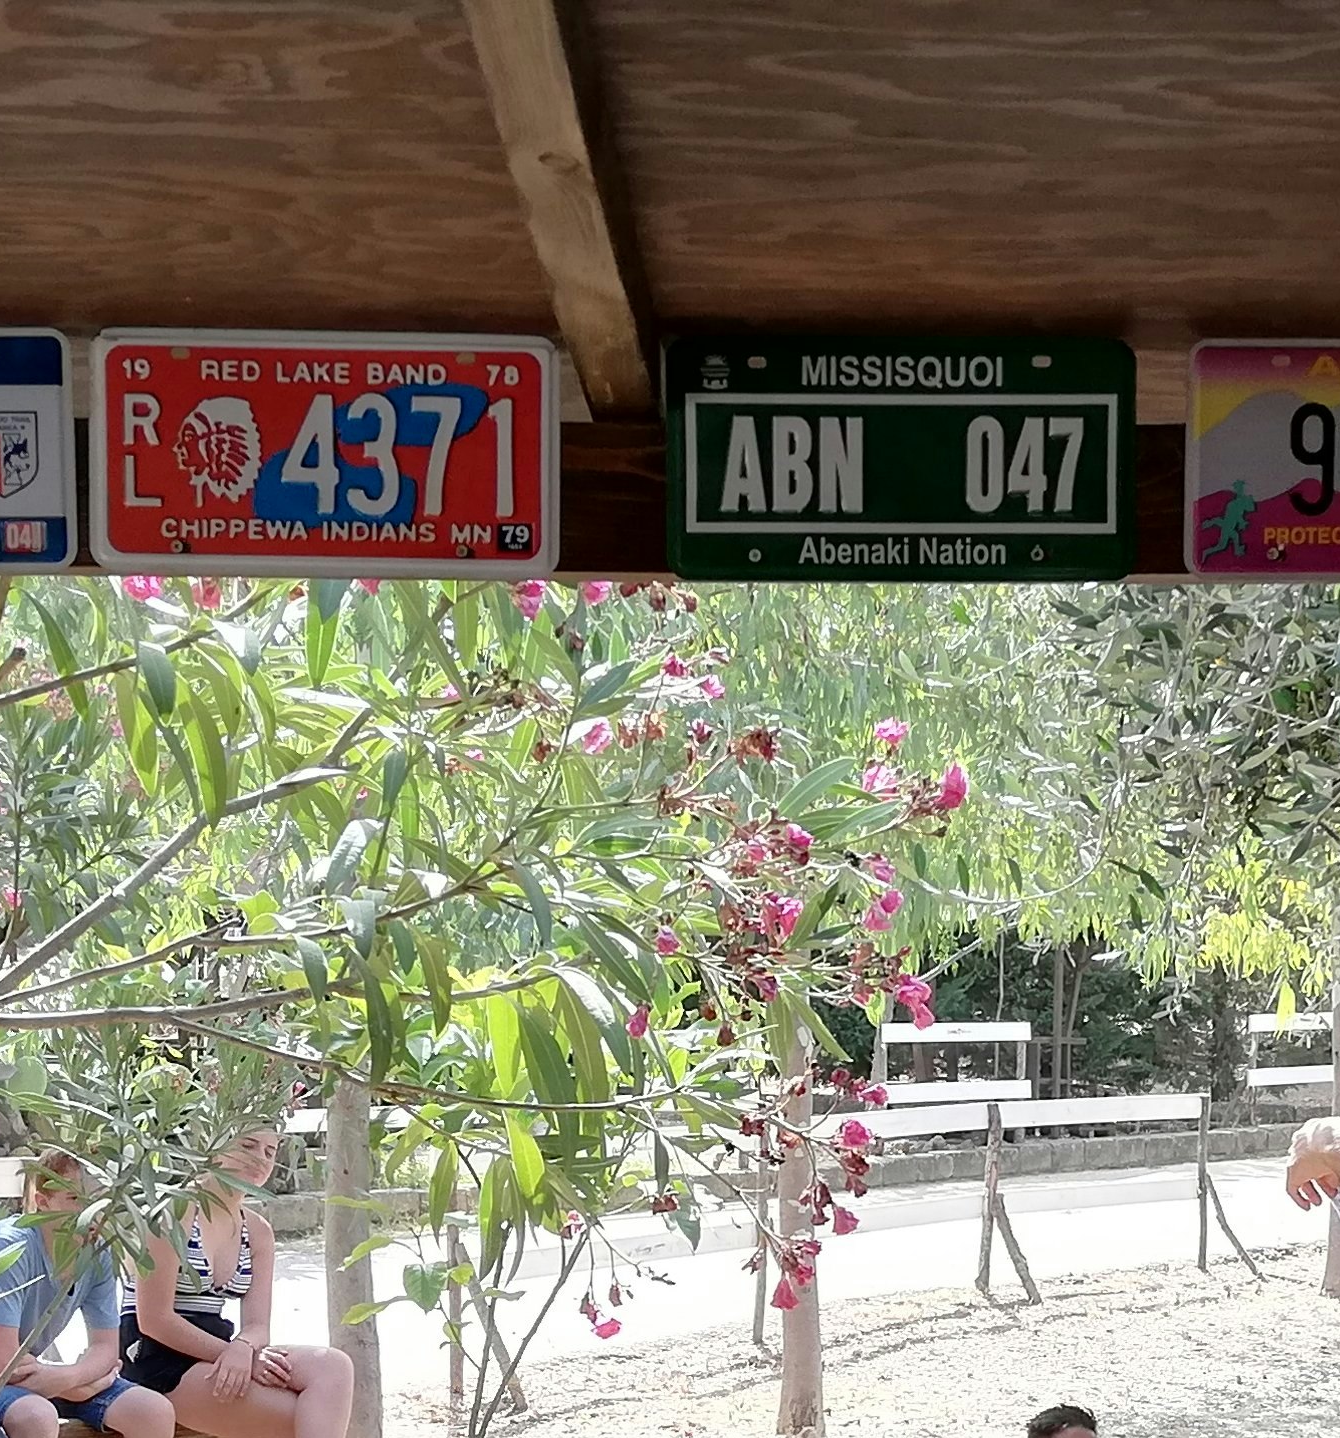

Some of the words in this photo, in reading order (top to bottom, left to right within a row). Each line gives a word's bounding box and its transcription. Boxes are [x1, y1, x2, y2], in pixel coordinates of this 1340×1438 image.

[123, 360, 151, 381] 19
[200, 359, 261, 382] RED
[276, 361, 350, 385] LAKE
[366, 362, 448, 387] BAND
[801, 355, 1004, 388] MISSISQUOI
[281, 393, 516, 519] 4371
[719, 414, 865, 514] ABN
[965, 414, 1085, 514] 047
[161, 517, 309, 541] CHIPPEWA
[321, 520, 437, 544] INDIANS
[450, 525, 492, 545] MN
[501, 525, 530, 544] 79
[798, 536, 910, 565] Abenaki
[918, 536, 1007, 566] Nation
